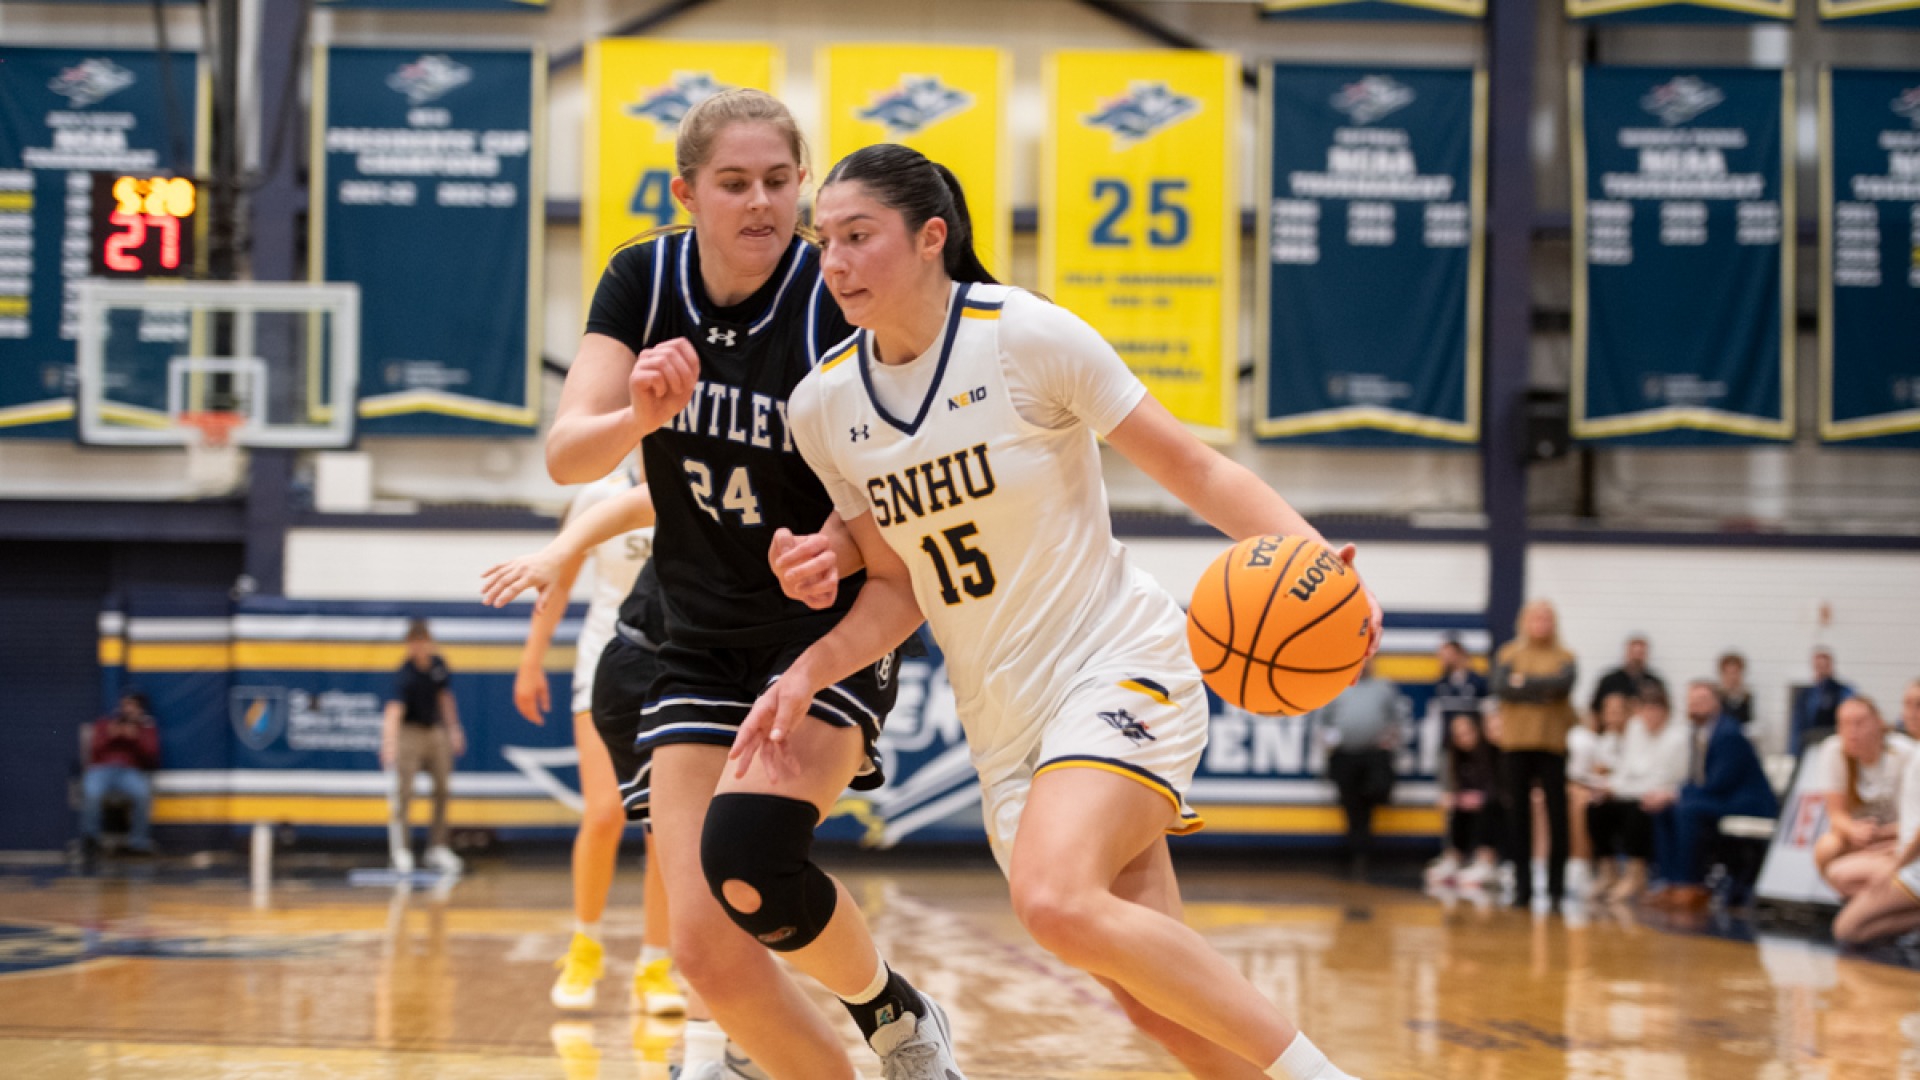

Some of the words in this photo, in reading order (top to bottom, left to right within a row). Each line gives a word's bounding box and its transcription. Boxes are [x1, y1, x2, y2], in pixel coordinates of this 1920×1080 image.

[104, 211, 180, 271] 27
[1090, 179, 1190, 247] 25
[662, 380, 794, 452] NTLEY
[682, 456, 764, 526] 24
[867, 443, 997, 527] SNHU
[921, 520, 998, 606] 15
